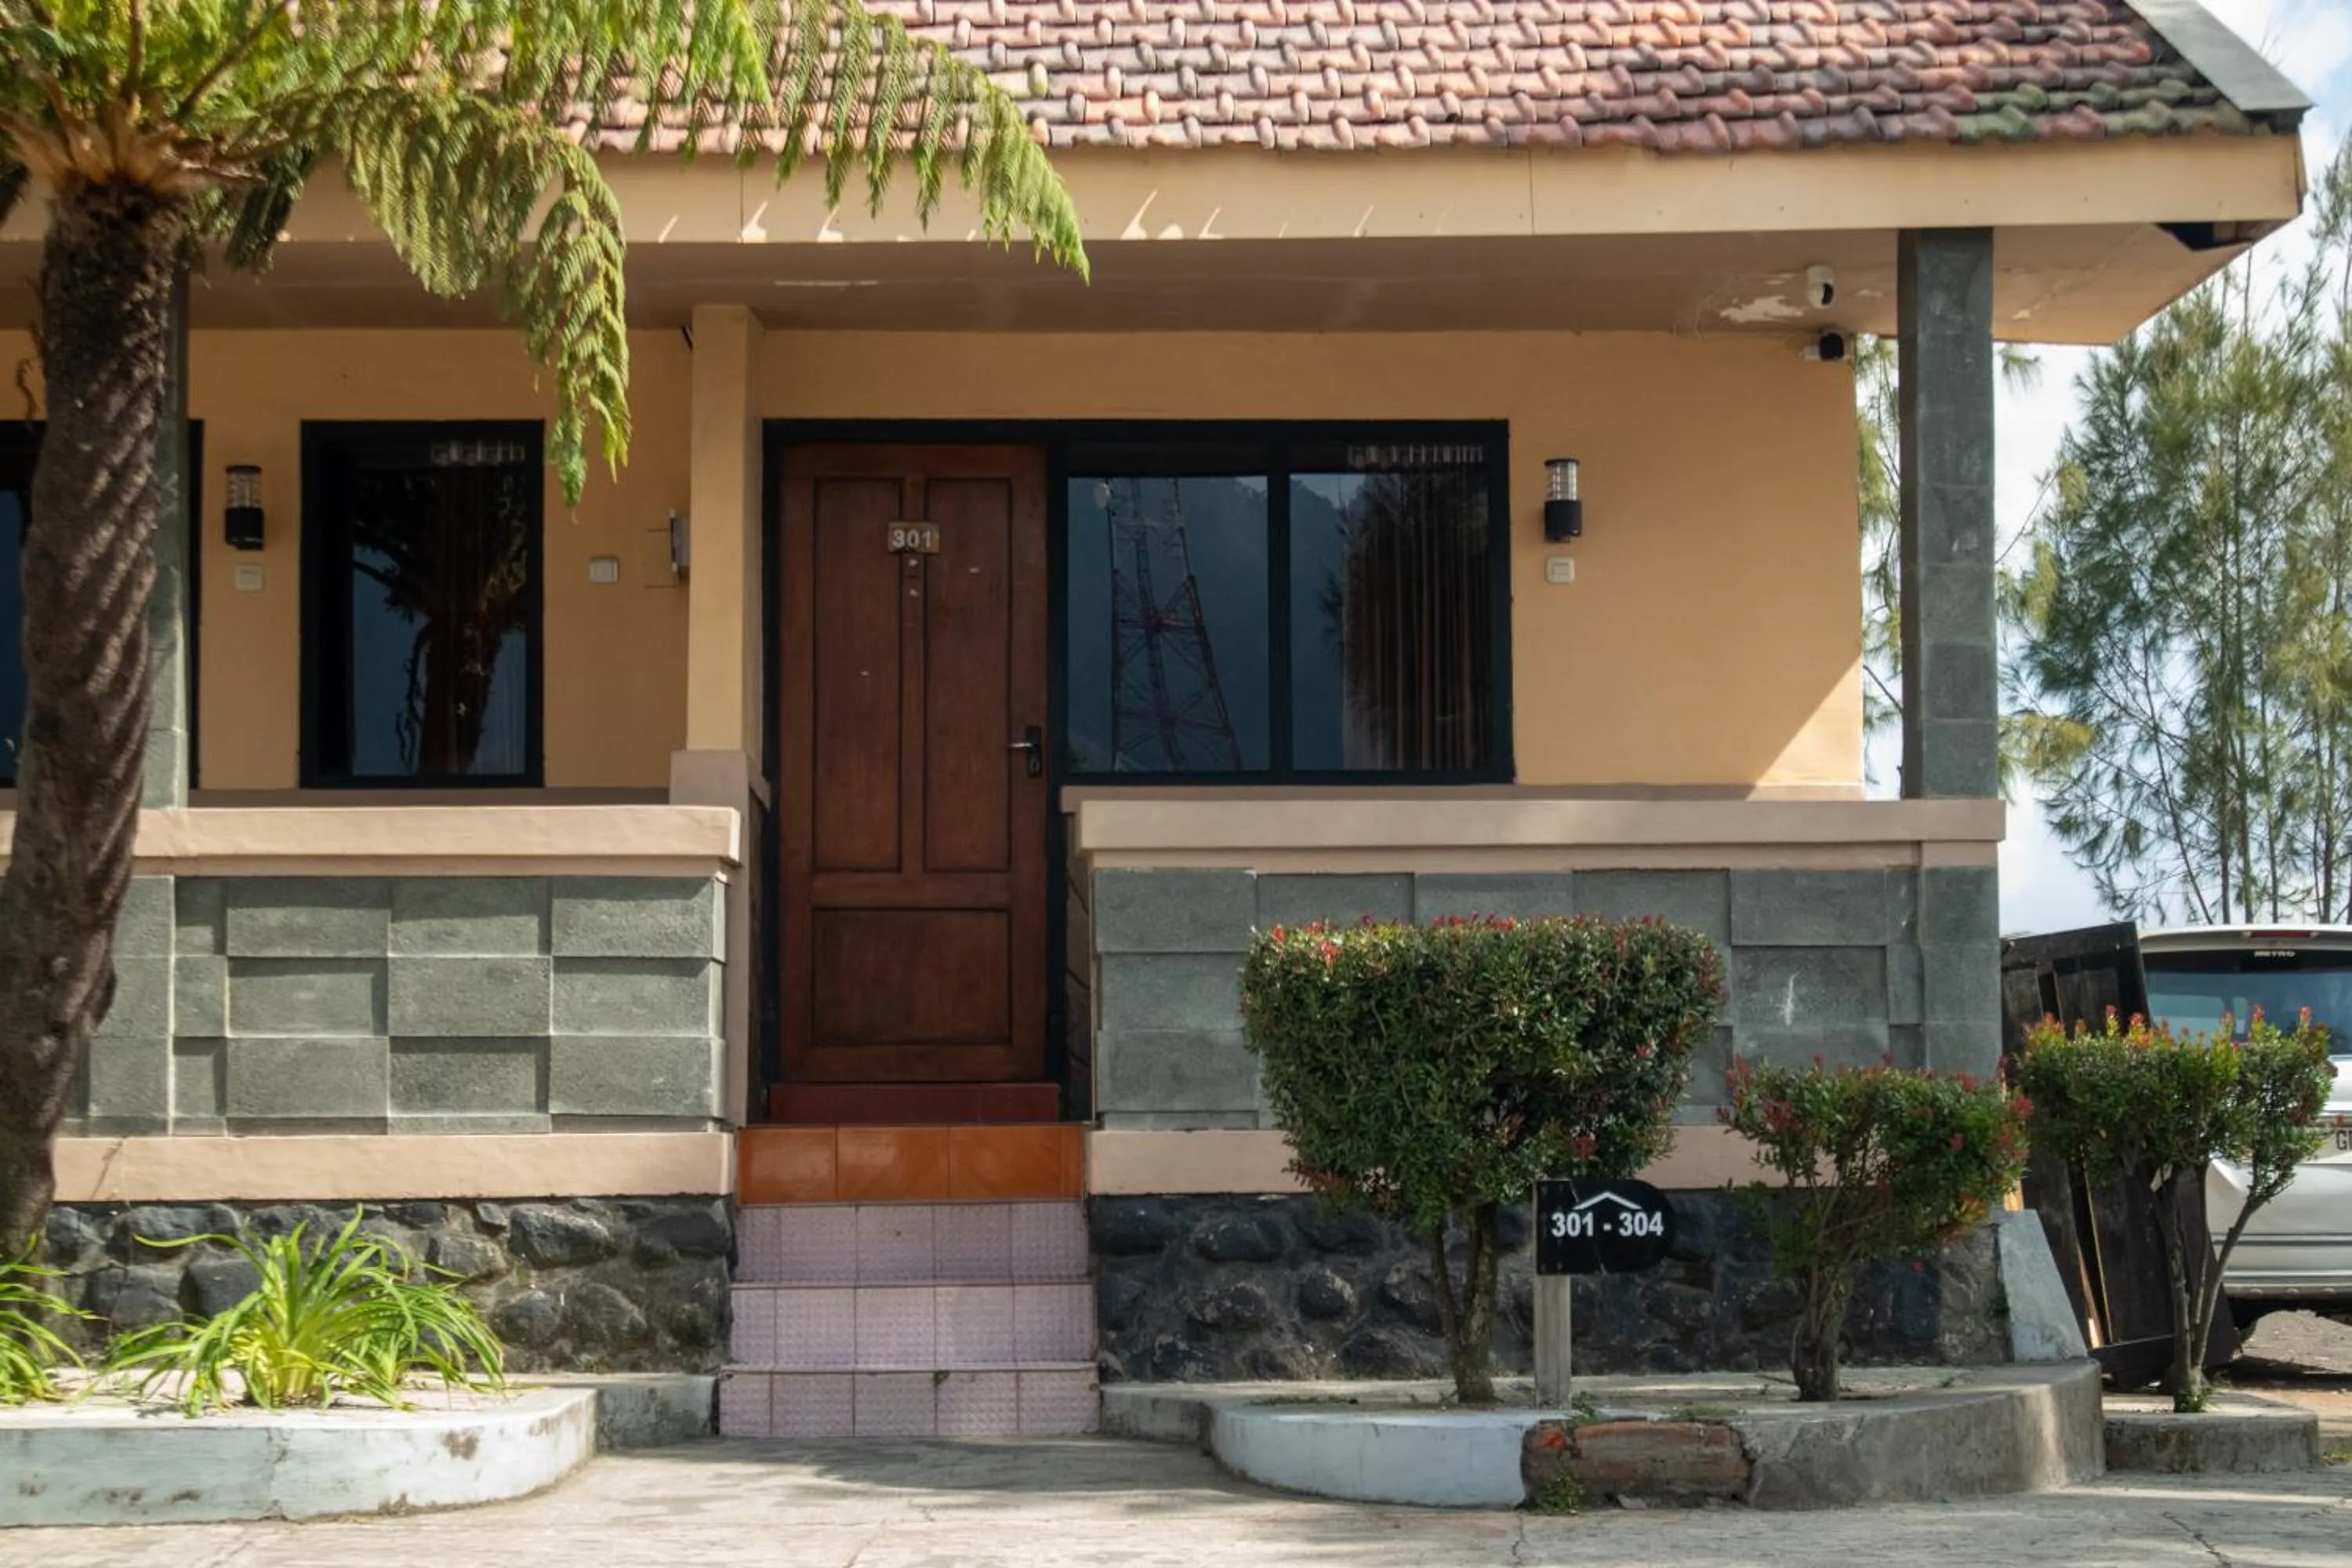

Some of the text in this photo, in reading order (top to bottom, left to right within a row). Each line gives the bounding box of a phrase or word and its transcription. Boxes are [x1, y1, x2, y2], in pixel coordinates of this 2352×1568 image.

[892, 529, 931, 548] 301
[1551, 1212, 1594, 1237] 301
[1618, 1211, 1664, 1237] 304
